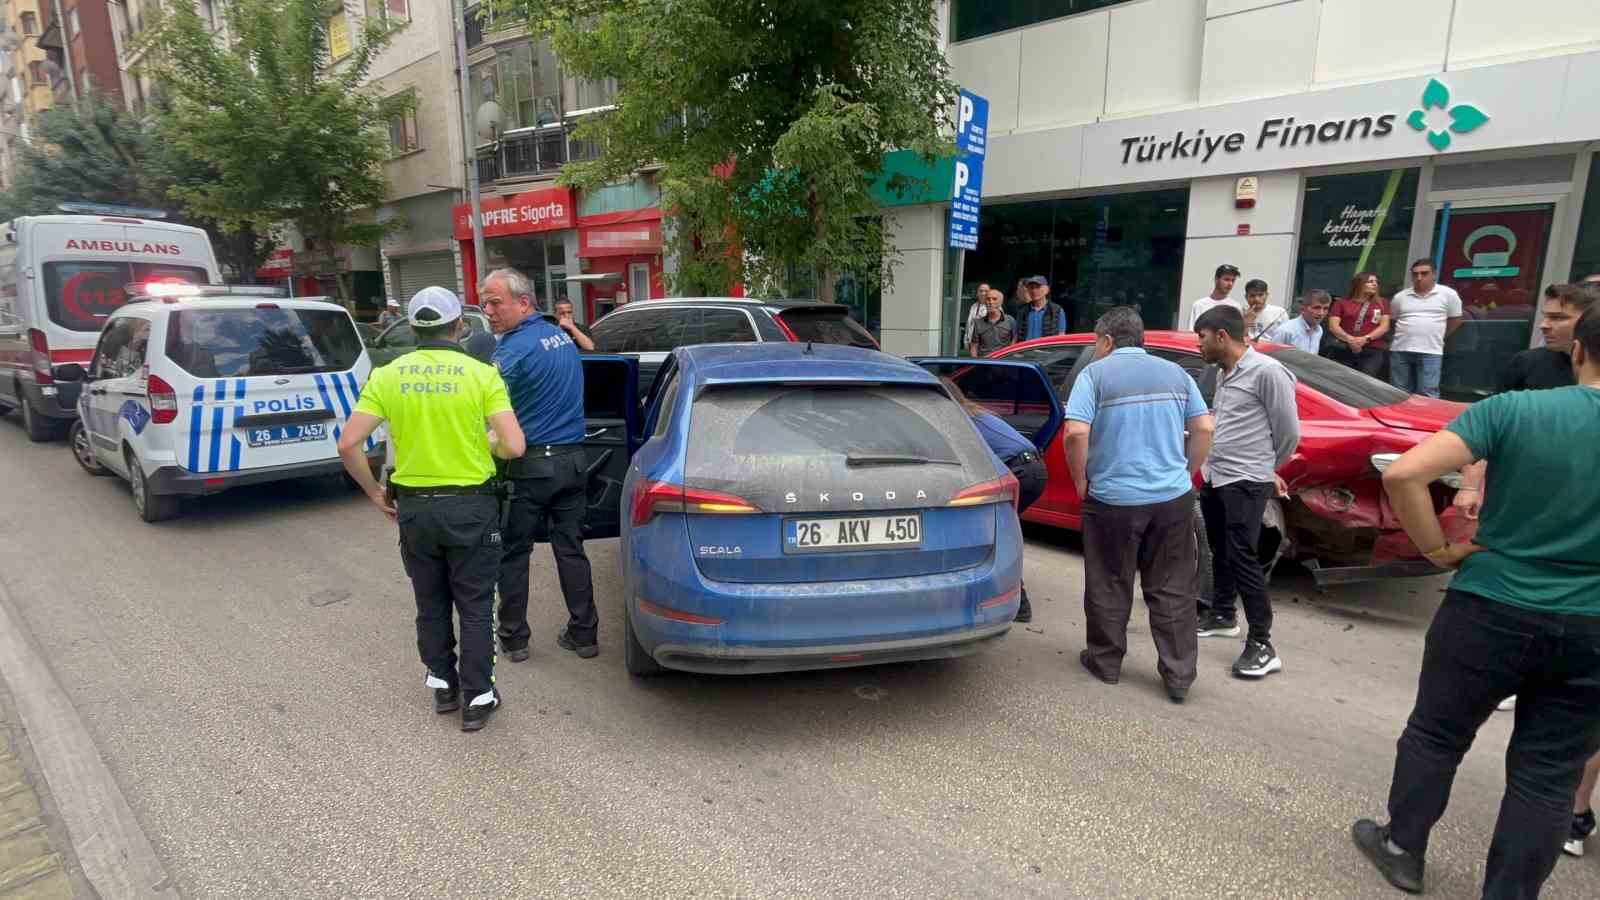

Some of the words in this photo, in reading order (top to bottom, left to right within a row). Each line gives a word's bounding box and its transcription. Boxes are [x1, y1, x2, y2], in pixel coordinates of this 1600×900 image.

[959, 95, 974, 134] P
[1120, 129, 1245, 164] Türkiye
[1255, 114, 1397, 151] Finans
[954, 161, 969, 198] P
[520, 201, 564, 224] Sigorta
[65, 239, 181, 255] AMBULANS
[253, 394, 315, 413] POLİS
[255, 429, 271, 441] 26
[281, 427, 288, 439] A
[296, 423, 324, 438] 7457
[798, 523, 822, 546] 26
[838, 520, 870, 544] AKV
[885, 518, 918, 541] 450
[699, 545, 742, 555] SCALA
